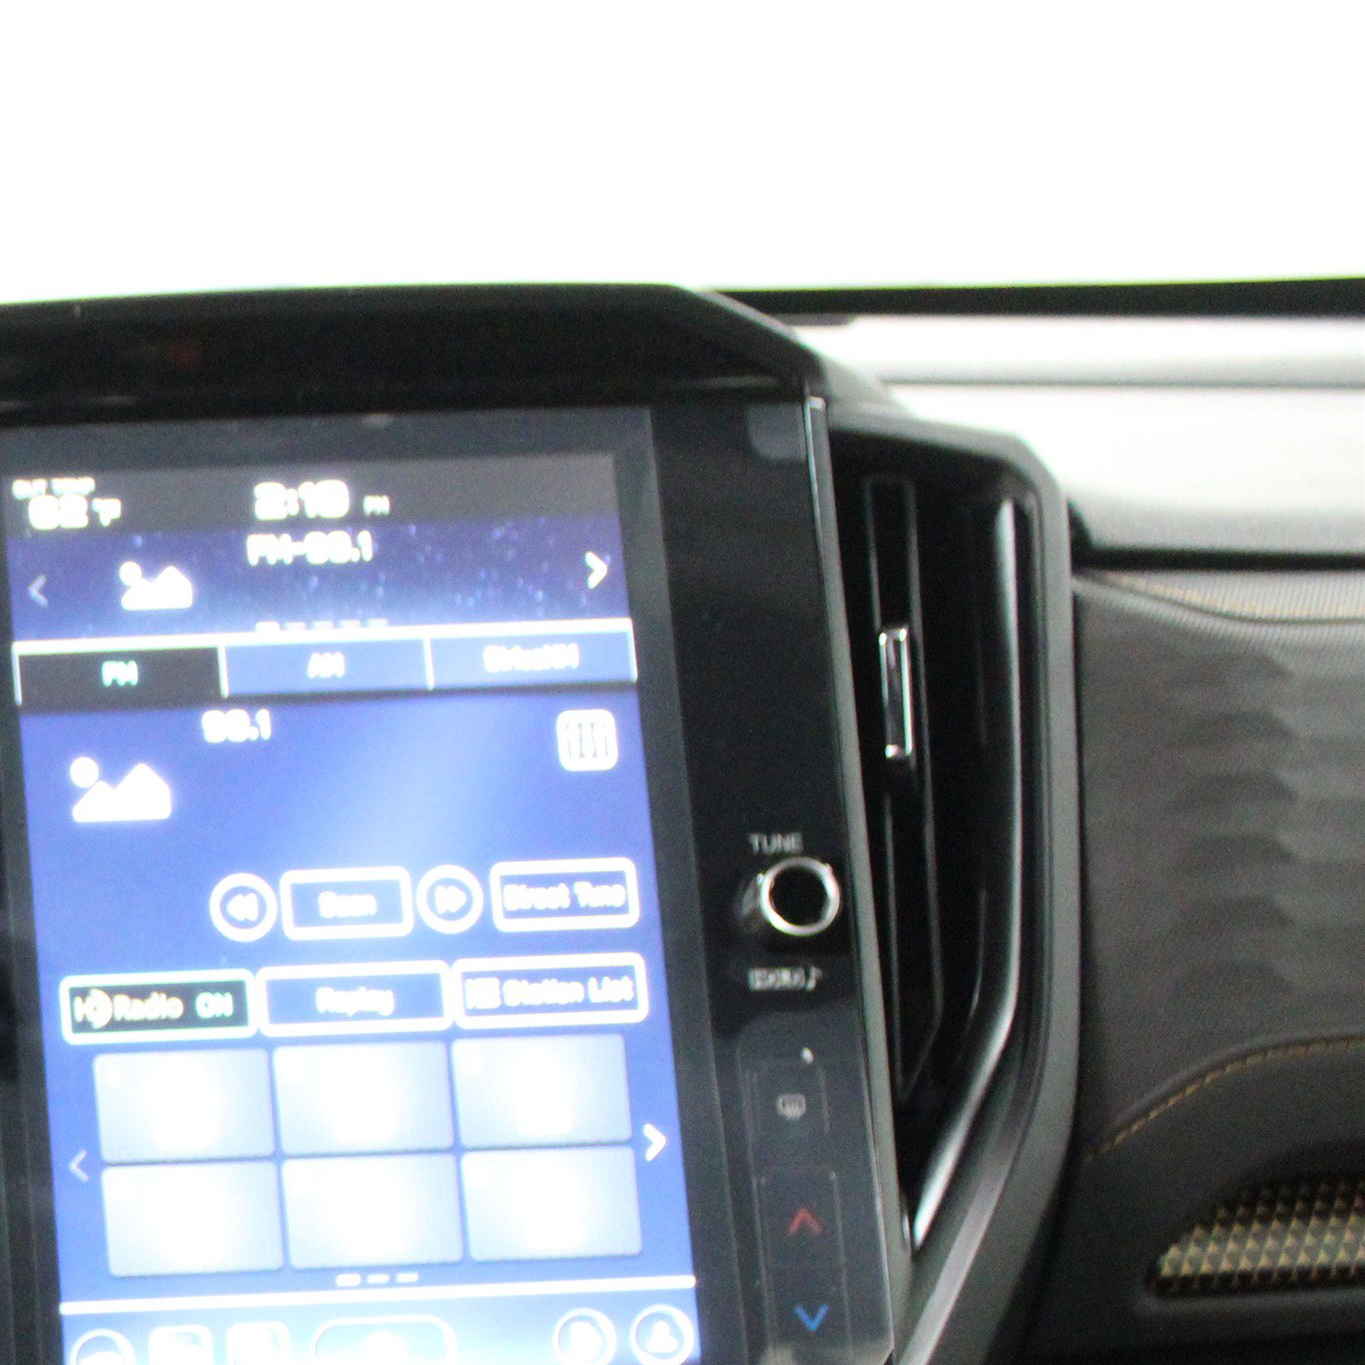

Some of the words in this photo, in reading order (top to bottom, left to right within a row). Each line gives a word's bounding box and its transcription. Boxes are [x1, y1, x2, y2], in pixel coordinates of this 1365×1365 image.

[102, 660, 137, 686] FM
[749, 832, 803, 854] TUNE
[113, 991, 183, 1021] Radio
[195, 992, 233, 1018] ON
